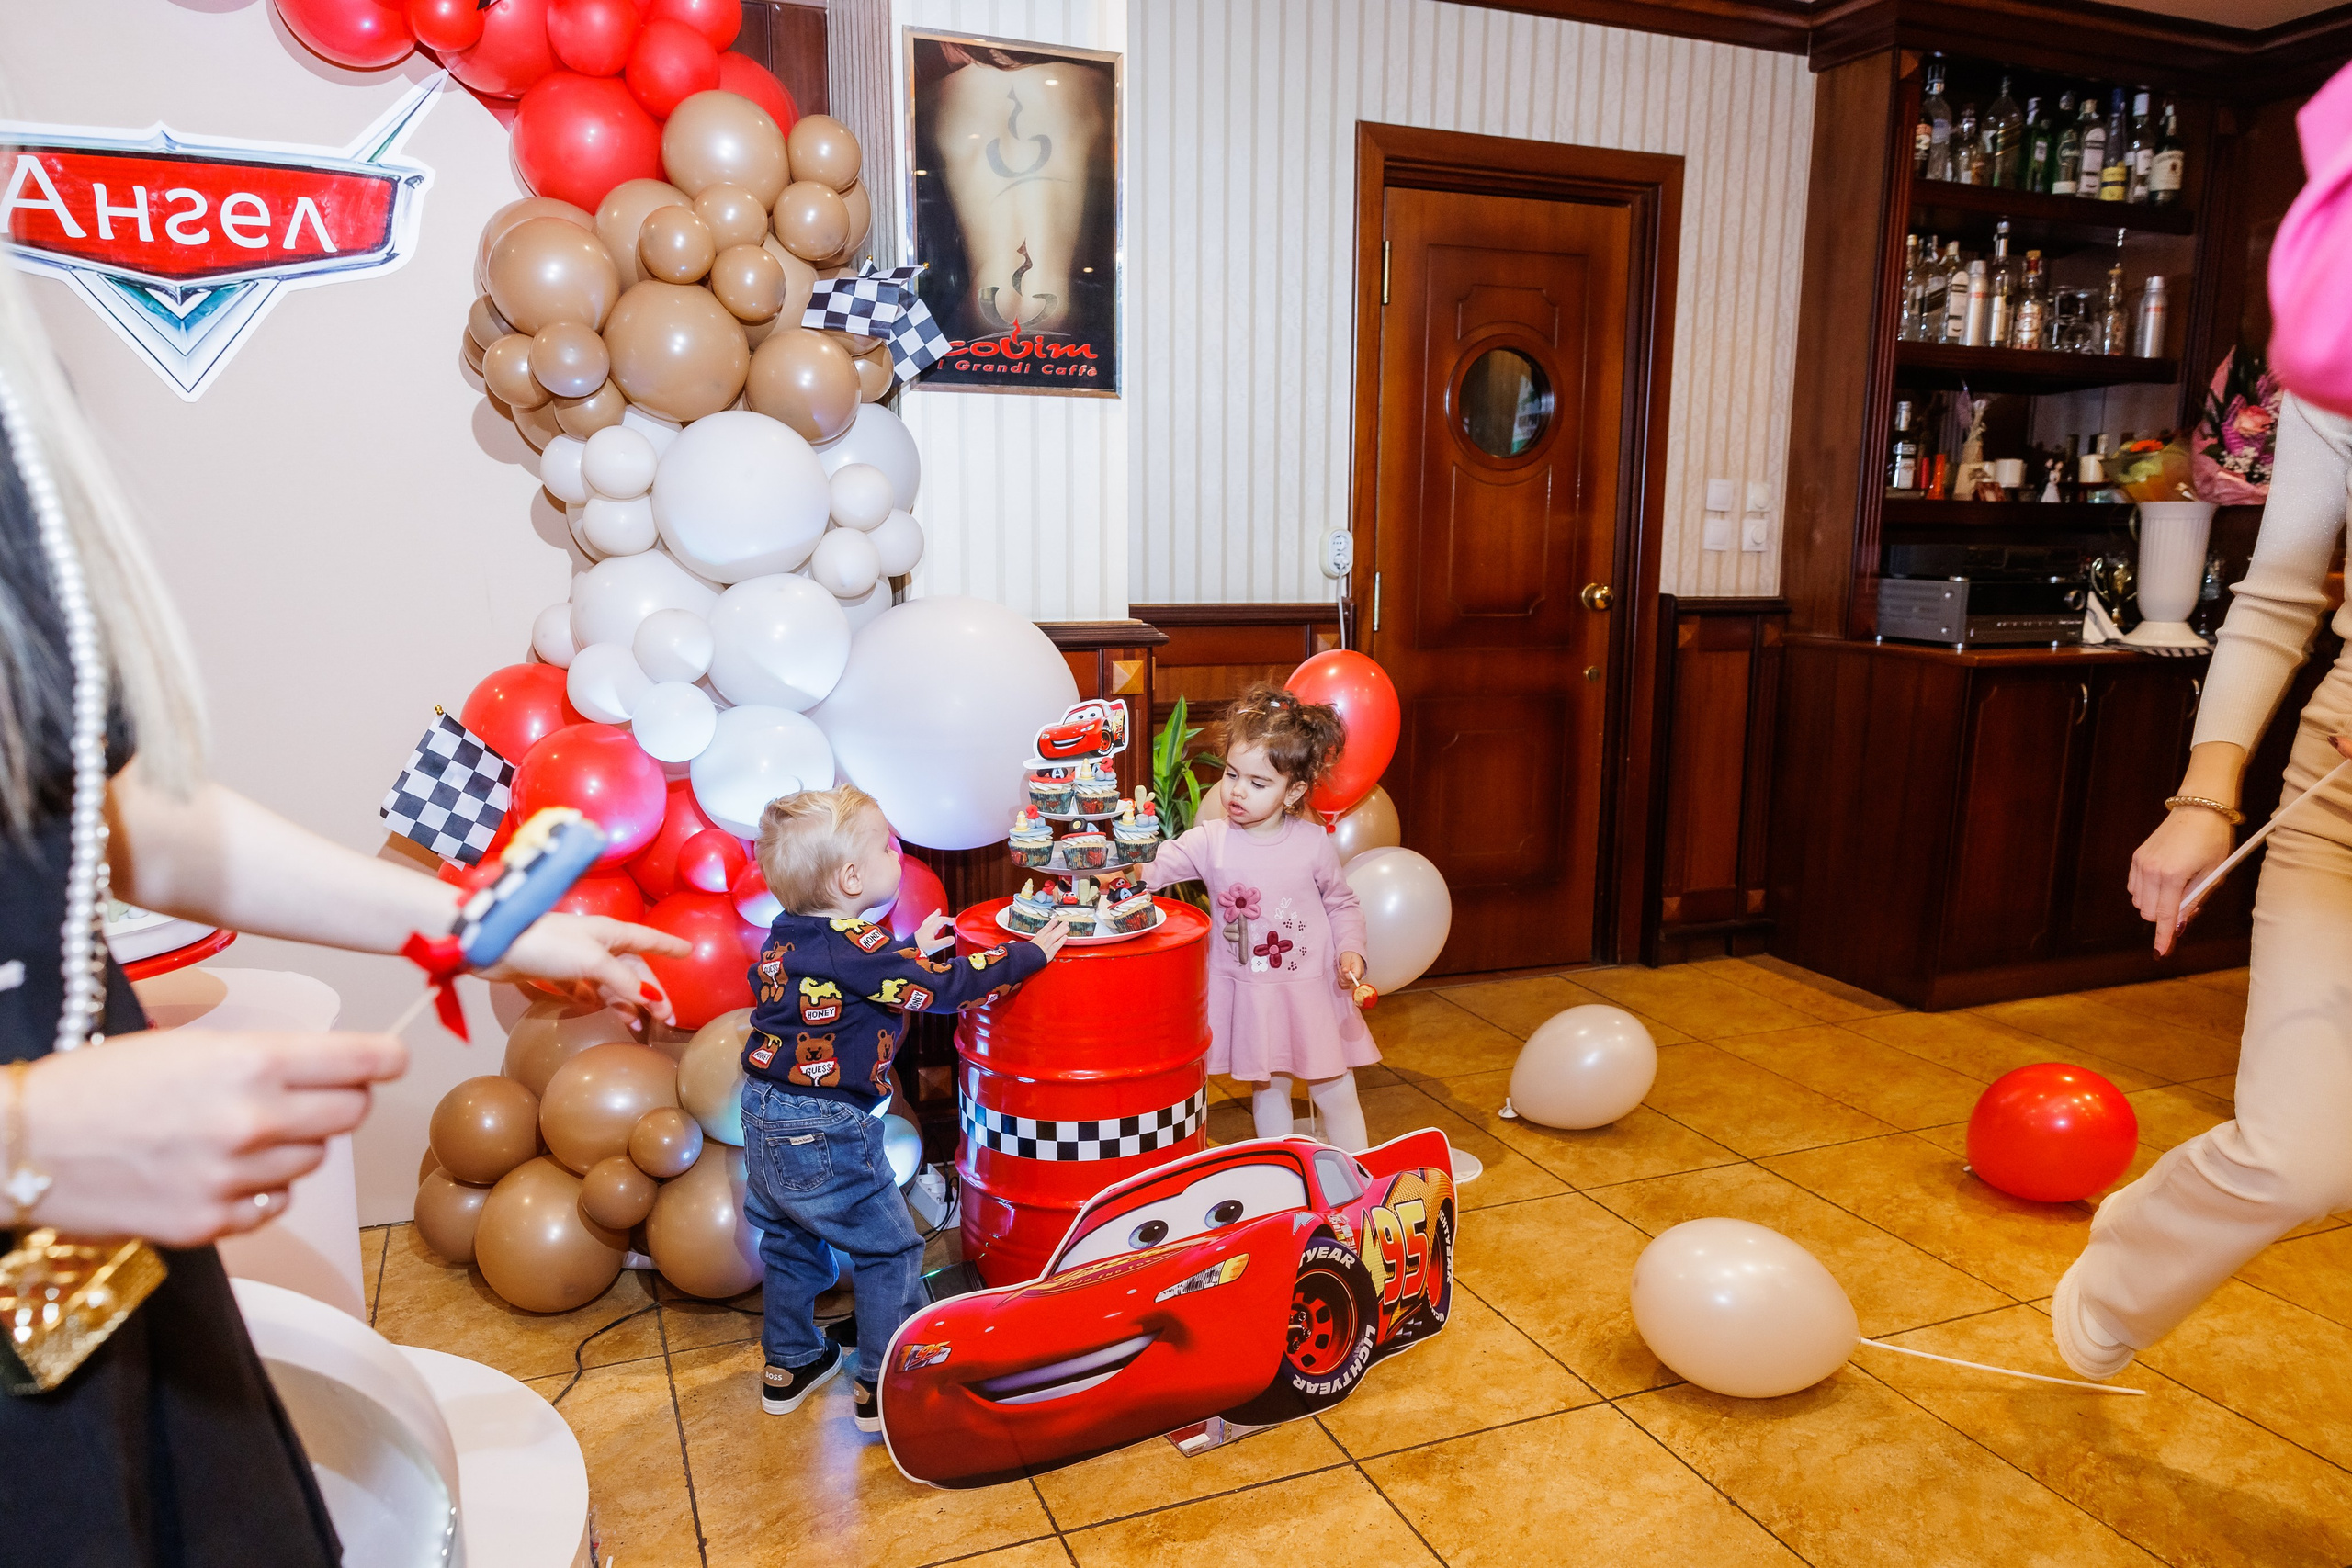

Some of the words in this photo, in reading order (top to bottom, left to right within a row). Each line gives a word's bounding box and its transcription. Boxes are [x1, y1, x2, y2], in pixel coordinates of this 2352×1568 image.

[955, 360, 1031, 374] Grandi
[1041, 364, 1099, 378] Caffè
[1100, 757, 1114, 773] 2
[1026, 804, 1039, 819] 2
[1143, 801, 1156, 816] 2
[862, 930, 882, 949] HONEY
[807, 1008, 834, 1020] HONEY
[806, 1063, 831, 1076] GUESS
[1371, 1199, 1429, 1307] 95
[910, 1341, 950, 1366] 95
[1292, 1324, 1376, 1395] LIGHTYEAR
[765, 1371, 783, 1382] BOSS
